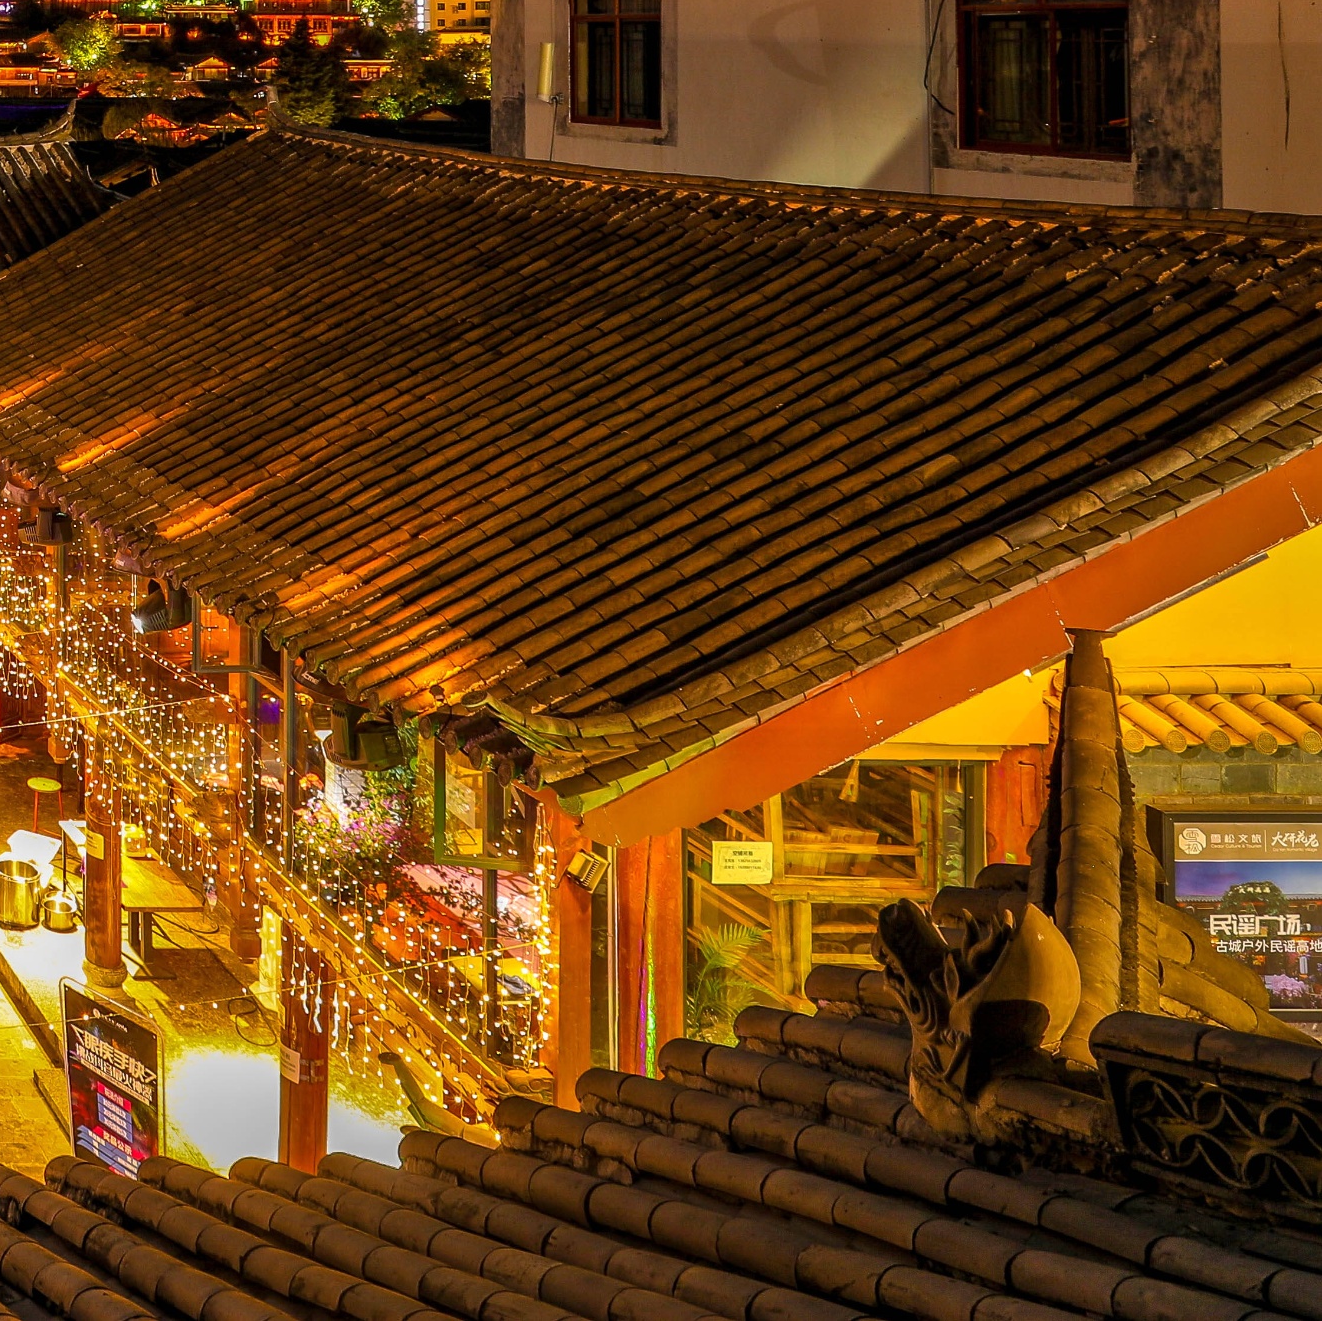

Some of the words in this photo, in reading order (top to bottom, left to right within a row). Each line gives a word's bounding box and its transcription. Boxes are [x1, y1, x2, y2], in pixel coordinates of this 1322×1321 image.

[1209, 914, 1301, 936] 民谣广场
[1216, 939, 1322, 953] 古城户外民谣高地
[83, 1030, 147, 1083] 眼疾手快
